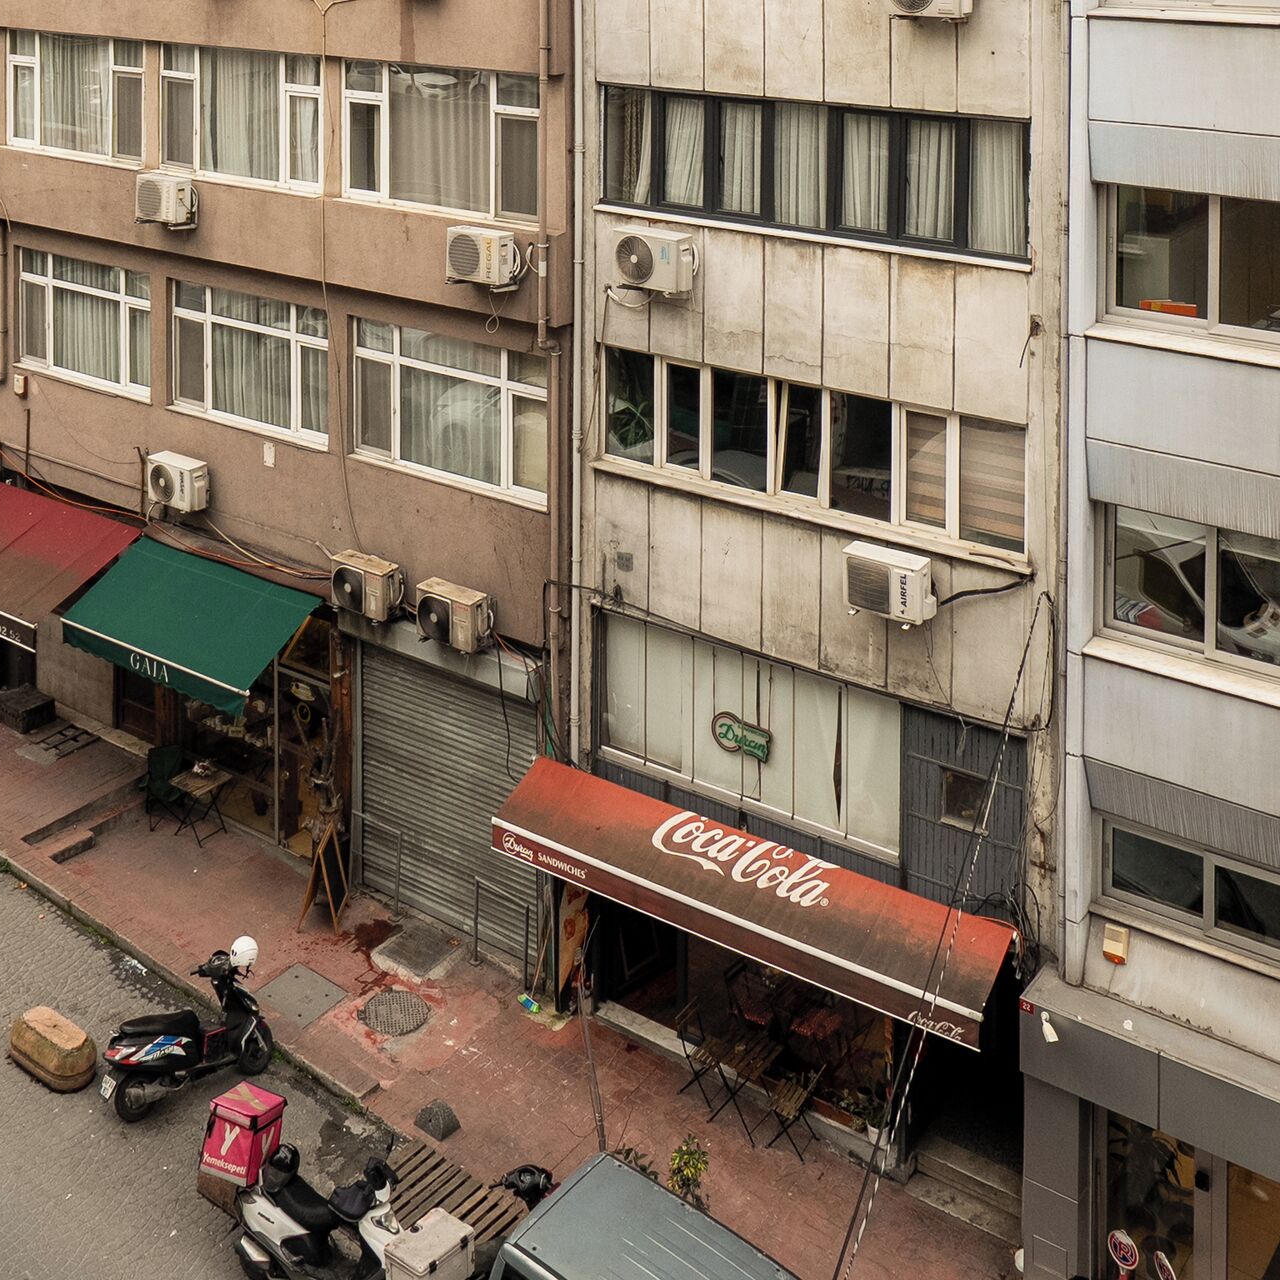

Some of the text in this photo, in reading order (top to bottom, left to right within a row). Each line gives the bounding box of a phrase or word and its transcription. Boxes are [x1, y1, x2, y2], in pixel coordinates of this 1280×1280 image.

[899, 573, 907, 607] AIRFEL
[9, 629, 21, 643] 52
[130, 652, 169, 683] GAIA
[537, 852, 586, 880] SANDWICHES
[1022, 1001, 1031, 1011] 22
[203, 1152, 247, 1175] Yemeksepeti
